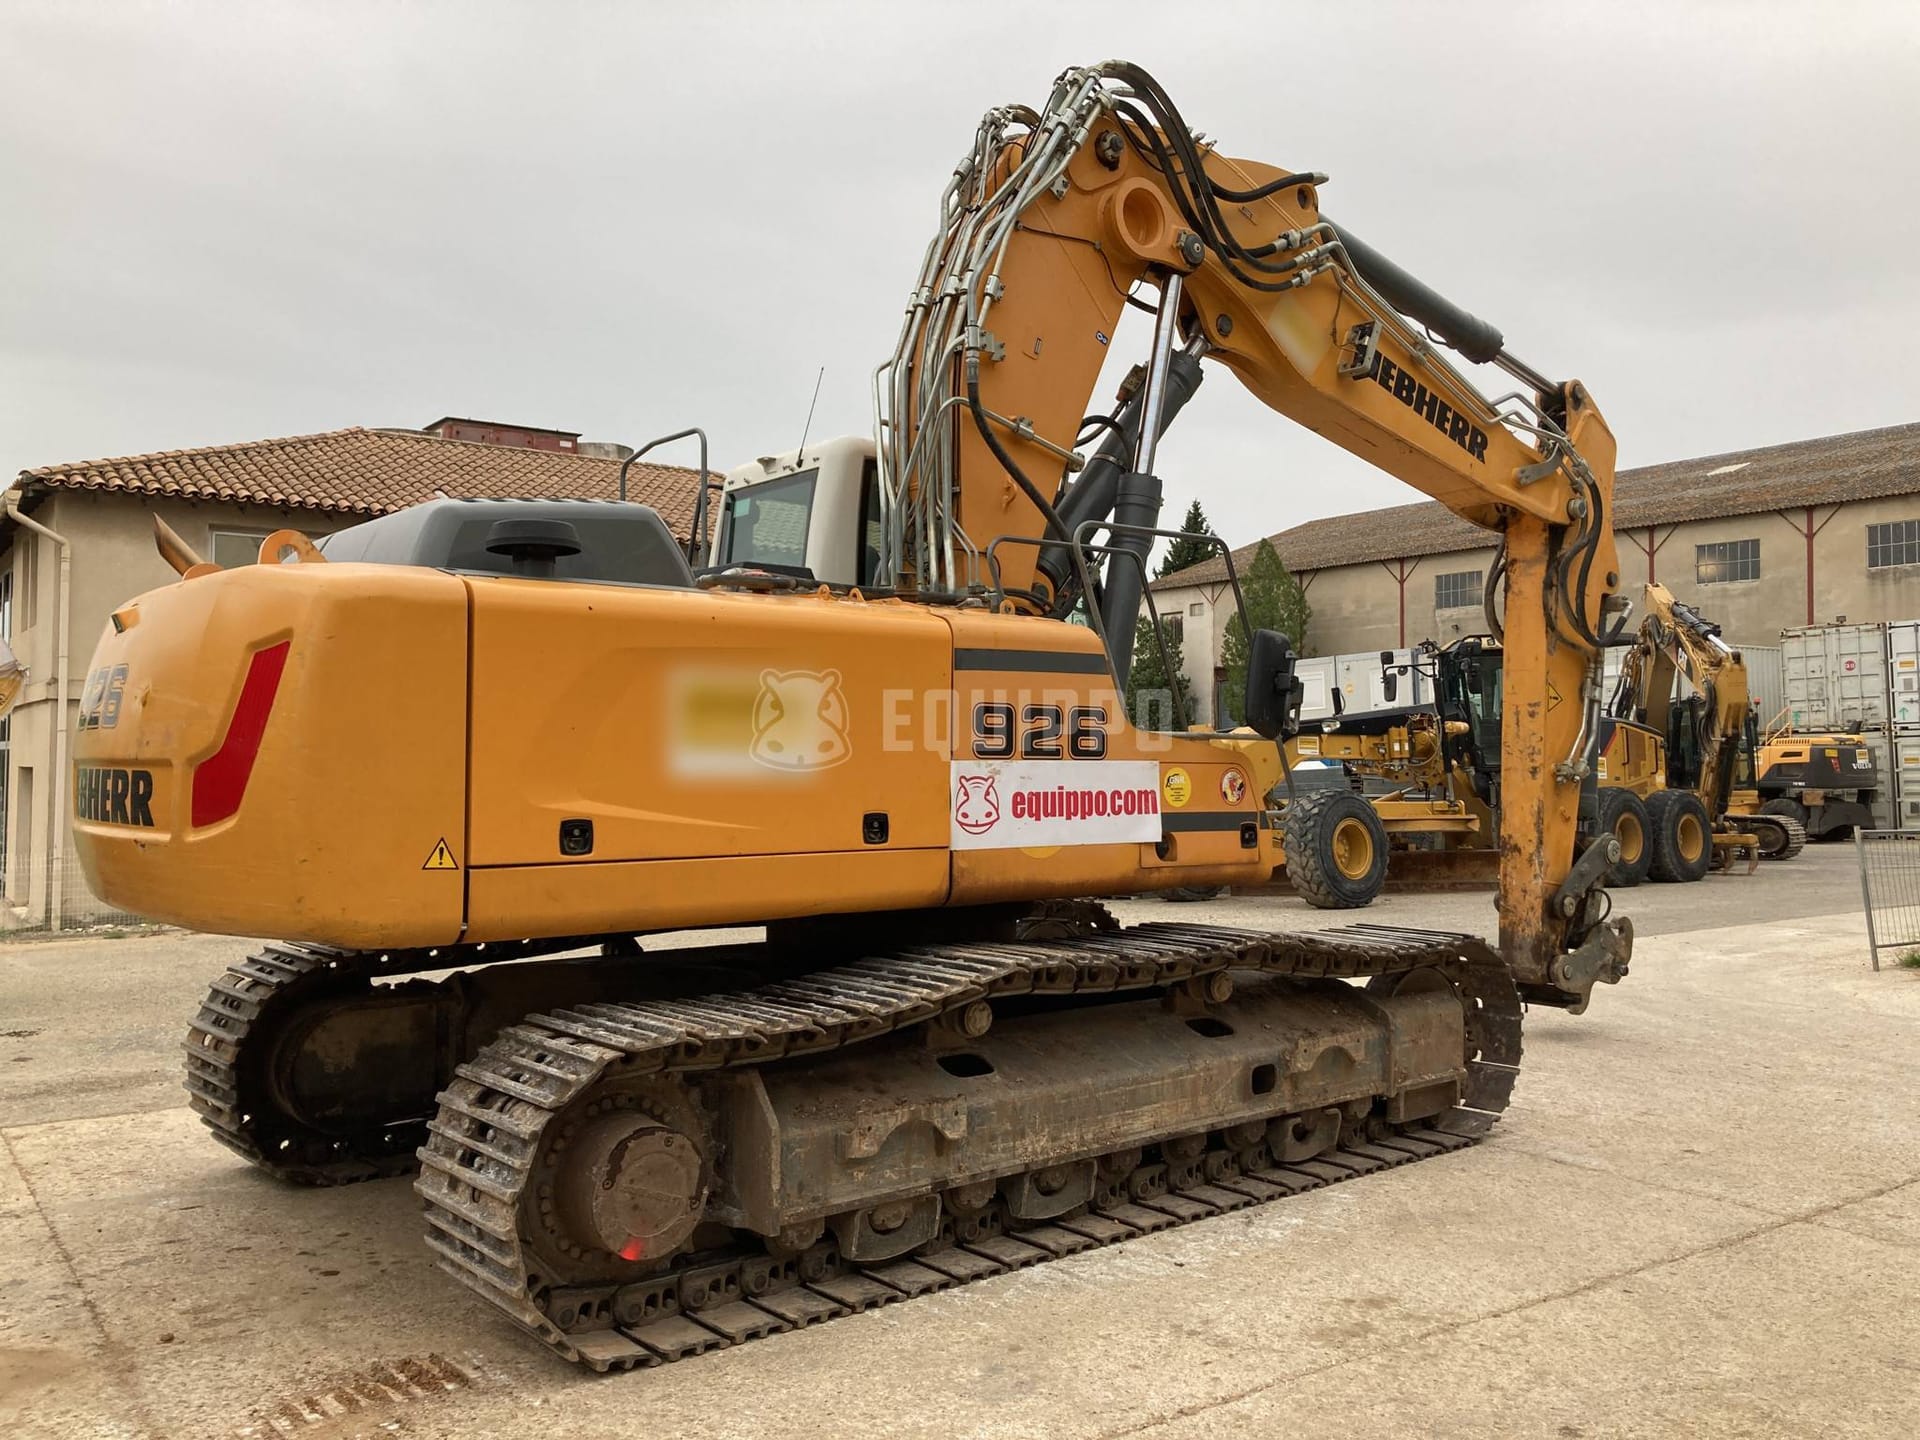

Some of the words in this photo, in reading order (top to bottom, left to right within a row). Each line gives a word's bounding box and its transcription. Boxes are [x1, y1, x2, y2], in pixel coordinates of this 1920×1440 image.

[1367, 350, 1488, 465] IEBHERR
[972, 702, 1107, 760] 926
[78, 767, 154, 827] BHERR
[1012, 786, 1158, 821] equippo.com
